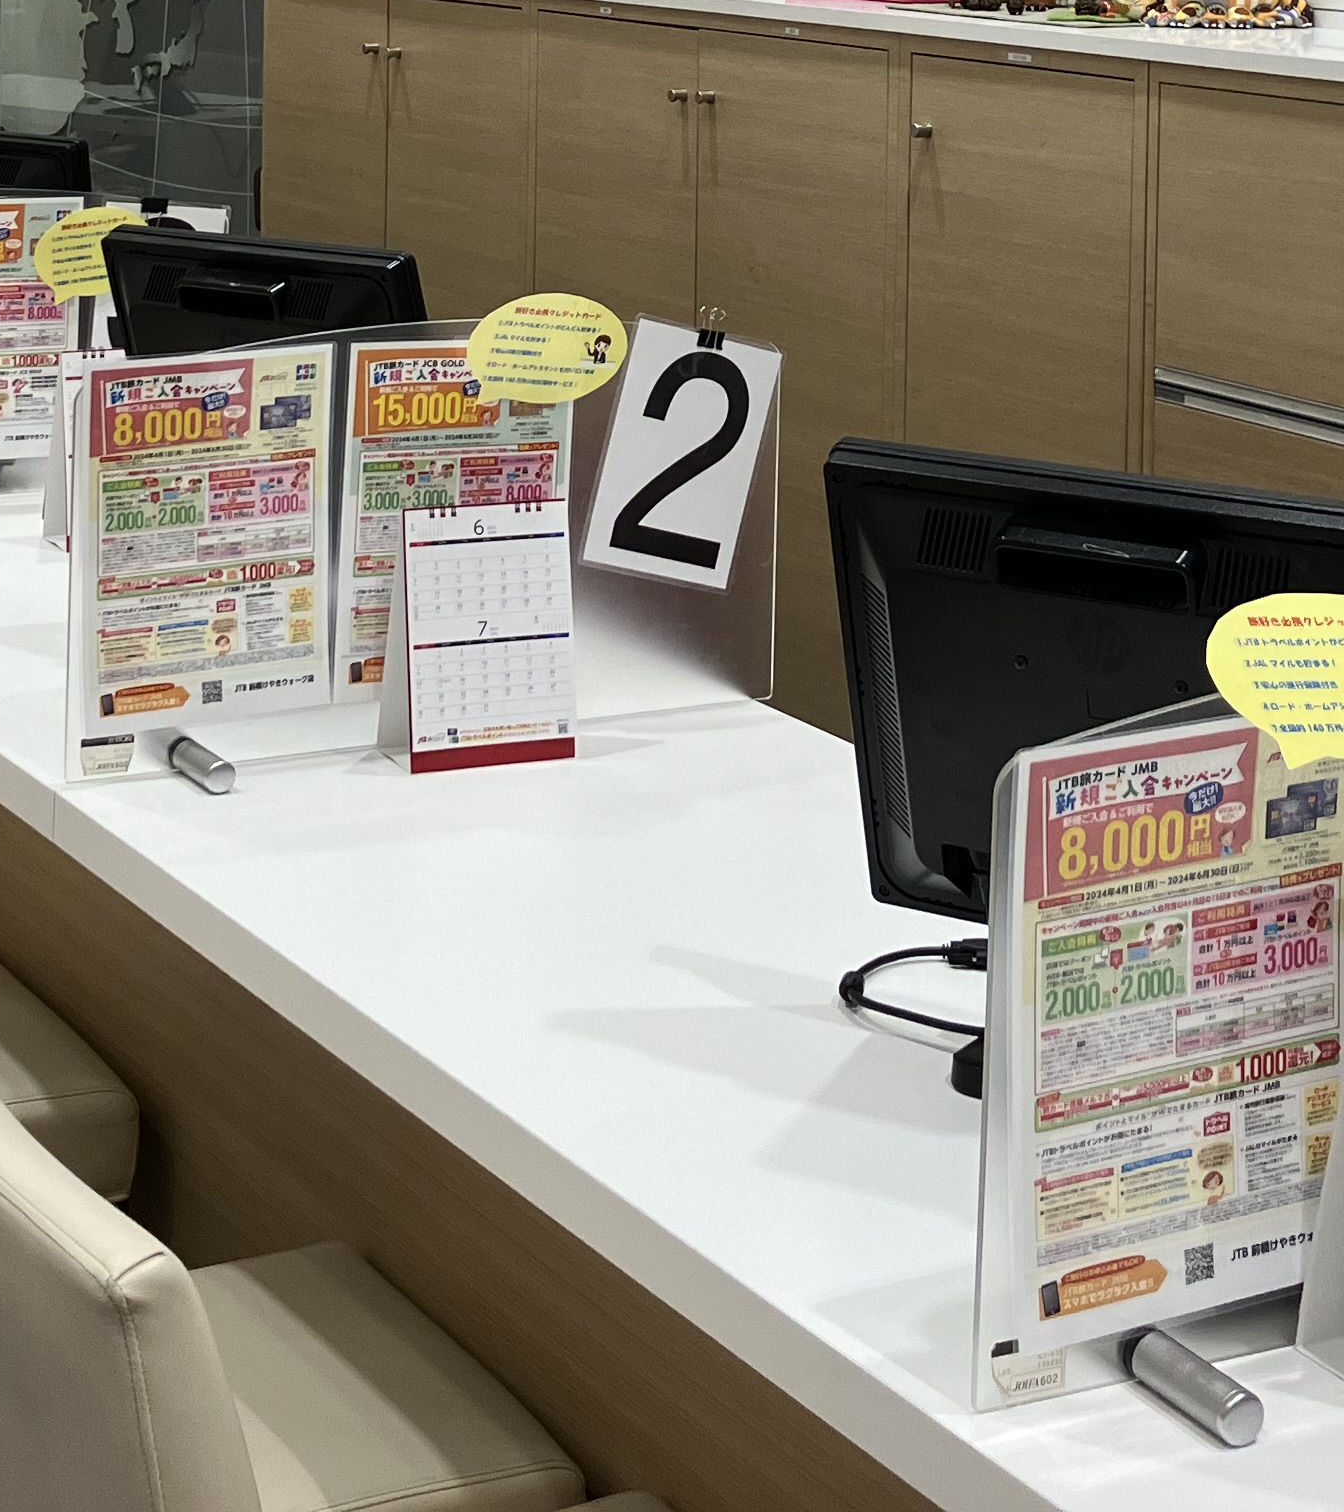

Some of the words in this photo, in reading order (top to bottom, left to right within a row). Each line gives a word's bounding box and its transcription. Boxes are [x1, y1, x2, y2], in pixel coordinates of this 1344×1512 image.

[422, 359, 438, 368] JCB
[440, 359, 465, 367] GOLD
[609, 351, 750, 570] 2
[473, 518, 485, 536] 6
[477, 620, 488, 637] 7
[1055, 768, 1233, 815] 新規ご入会キャンペーン
[1056, 766, 1126, 792] JTB旅カード
[1130, 761, 1159, 776] JMB
[1263, 936, 1317, 975] 3,000
[1045, 980, 1102, 1022] 2,000
[1120, 966, 1175, 1003] 2,000
[1236, 1046, 1287, 1084] 1,000
[1231, 1246, 1249, 1262] JTB
